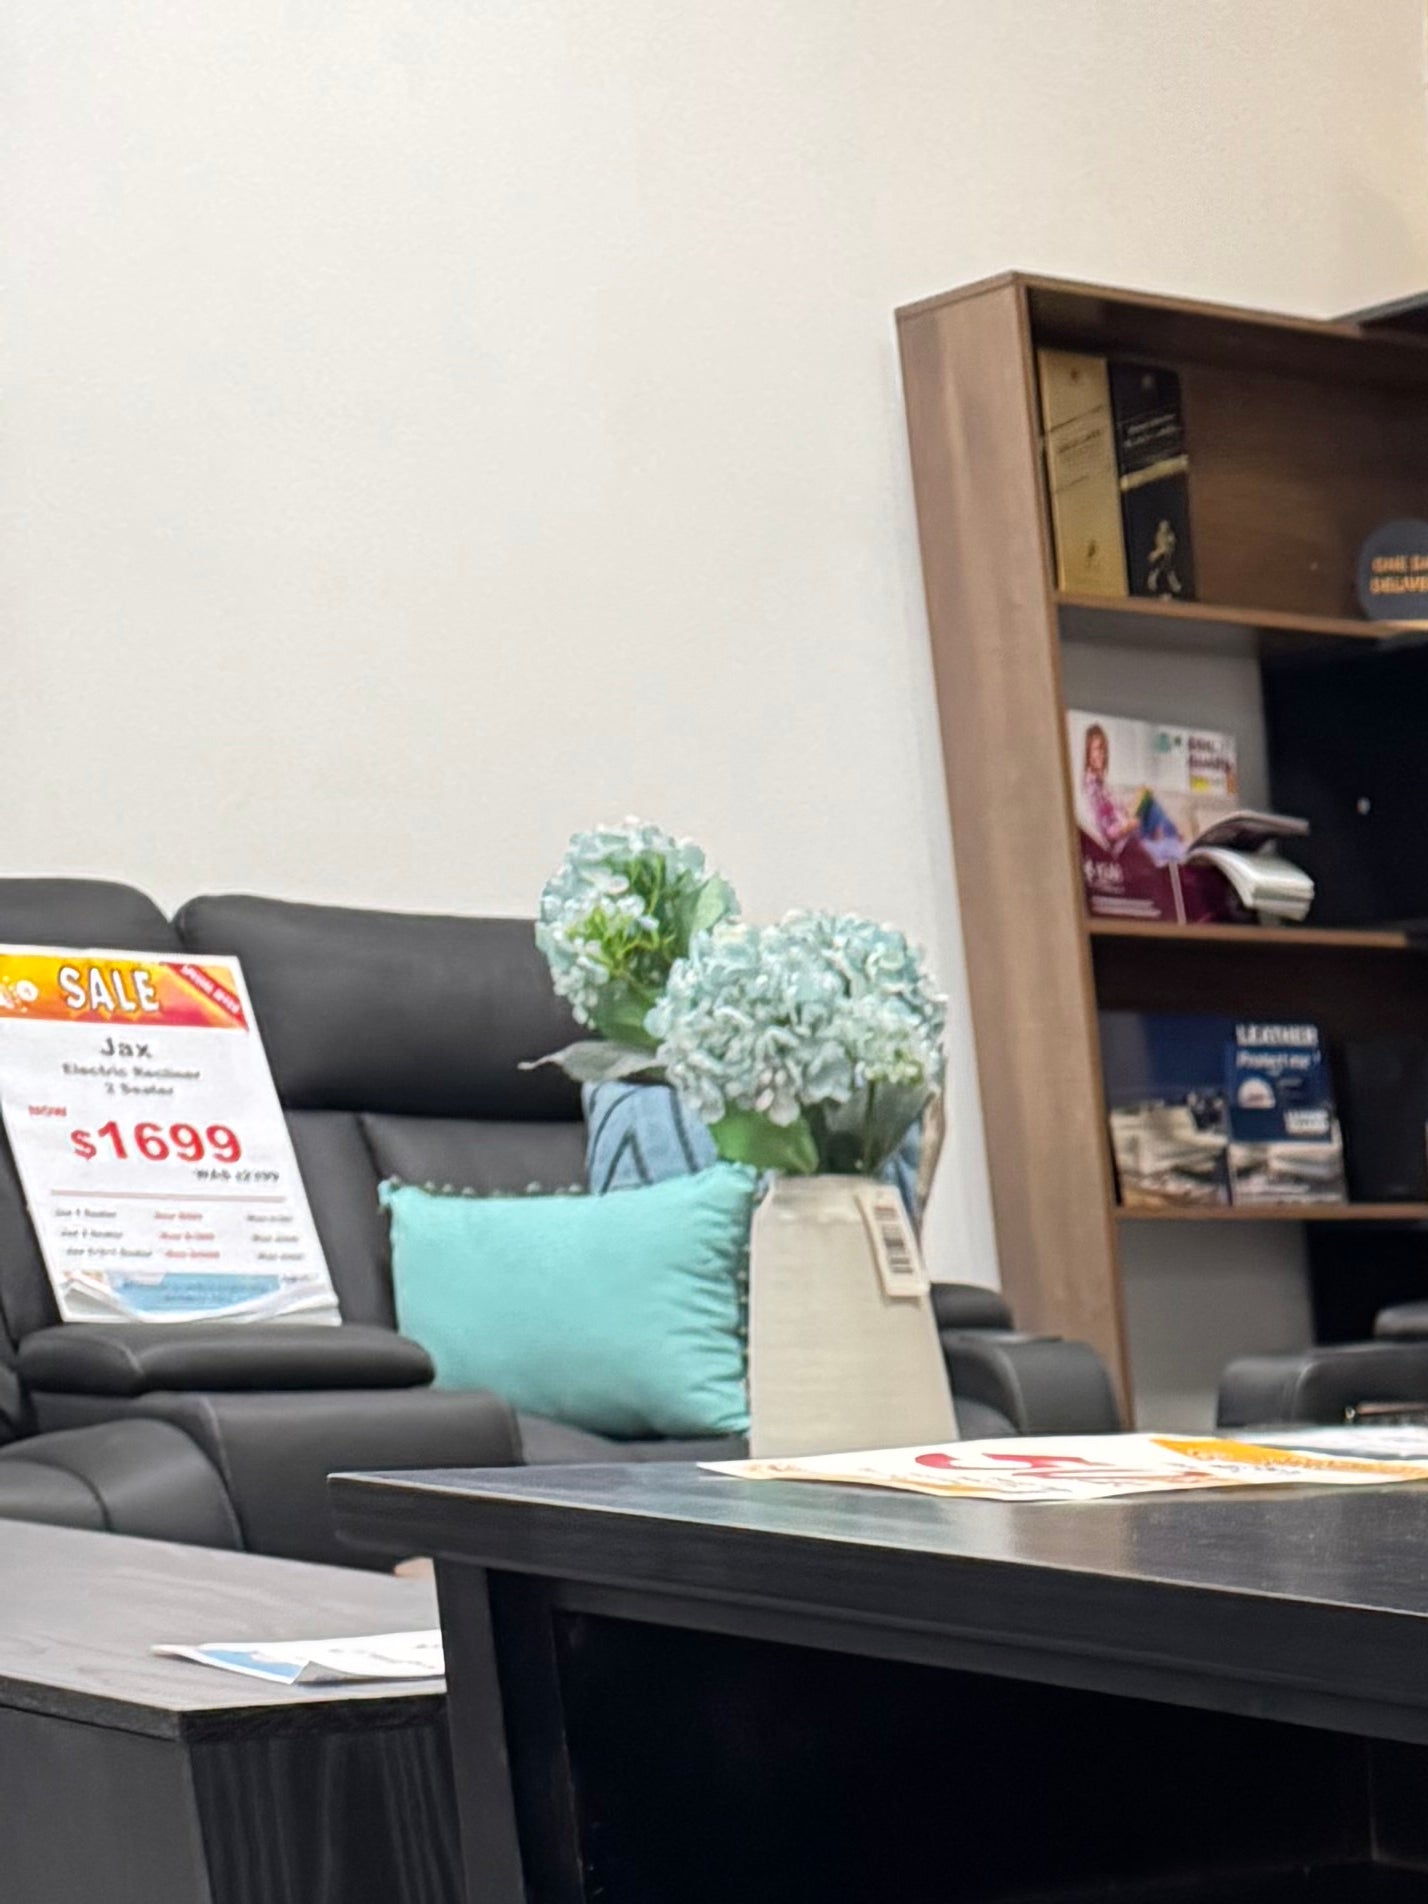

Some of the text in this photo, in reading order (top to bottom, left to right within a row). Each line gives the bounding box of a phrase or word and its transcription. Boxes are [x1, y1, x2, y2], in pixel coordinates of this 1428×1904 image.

[58, 966, 161, 1012] SALE
[99, 1037, 152, 1059] Jax
[70, 1119, 243, 1164] $1699
